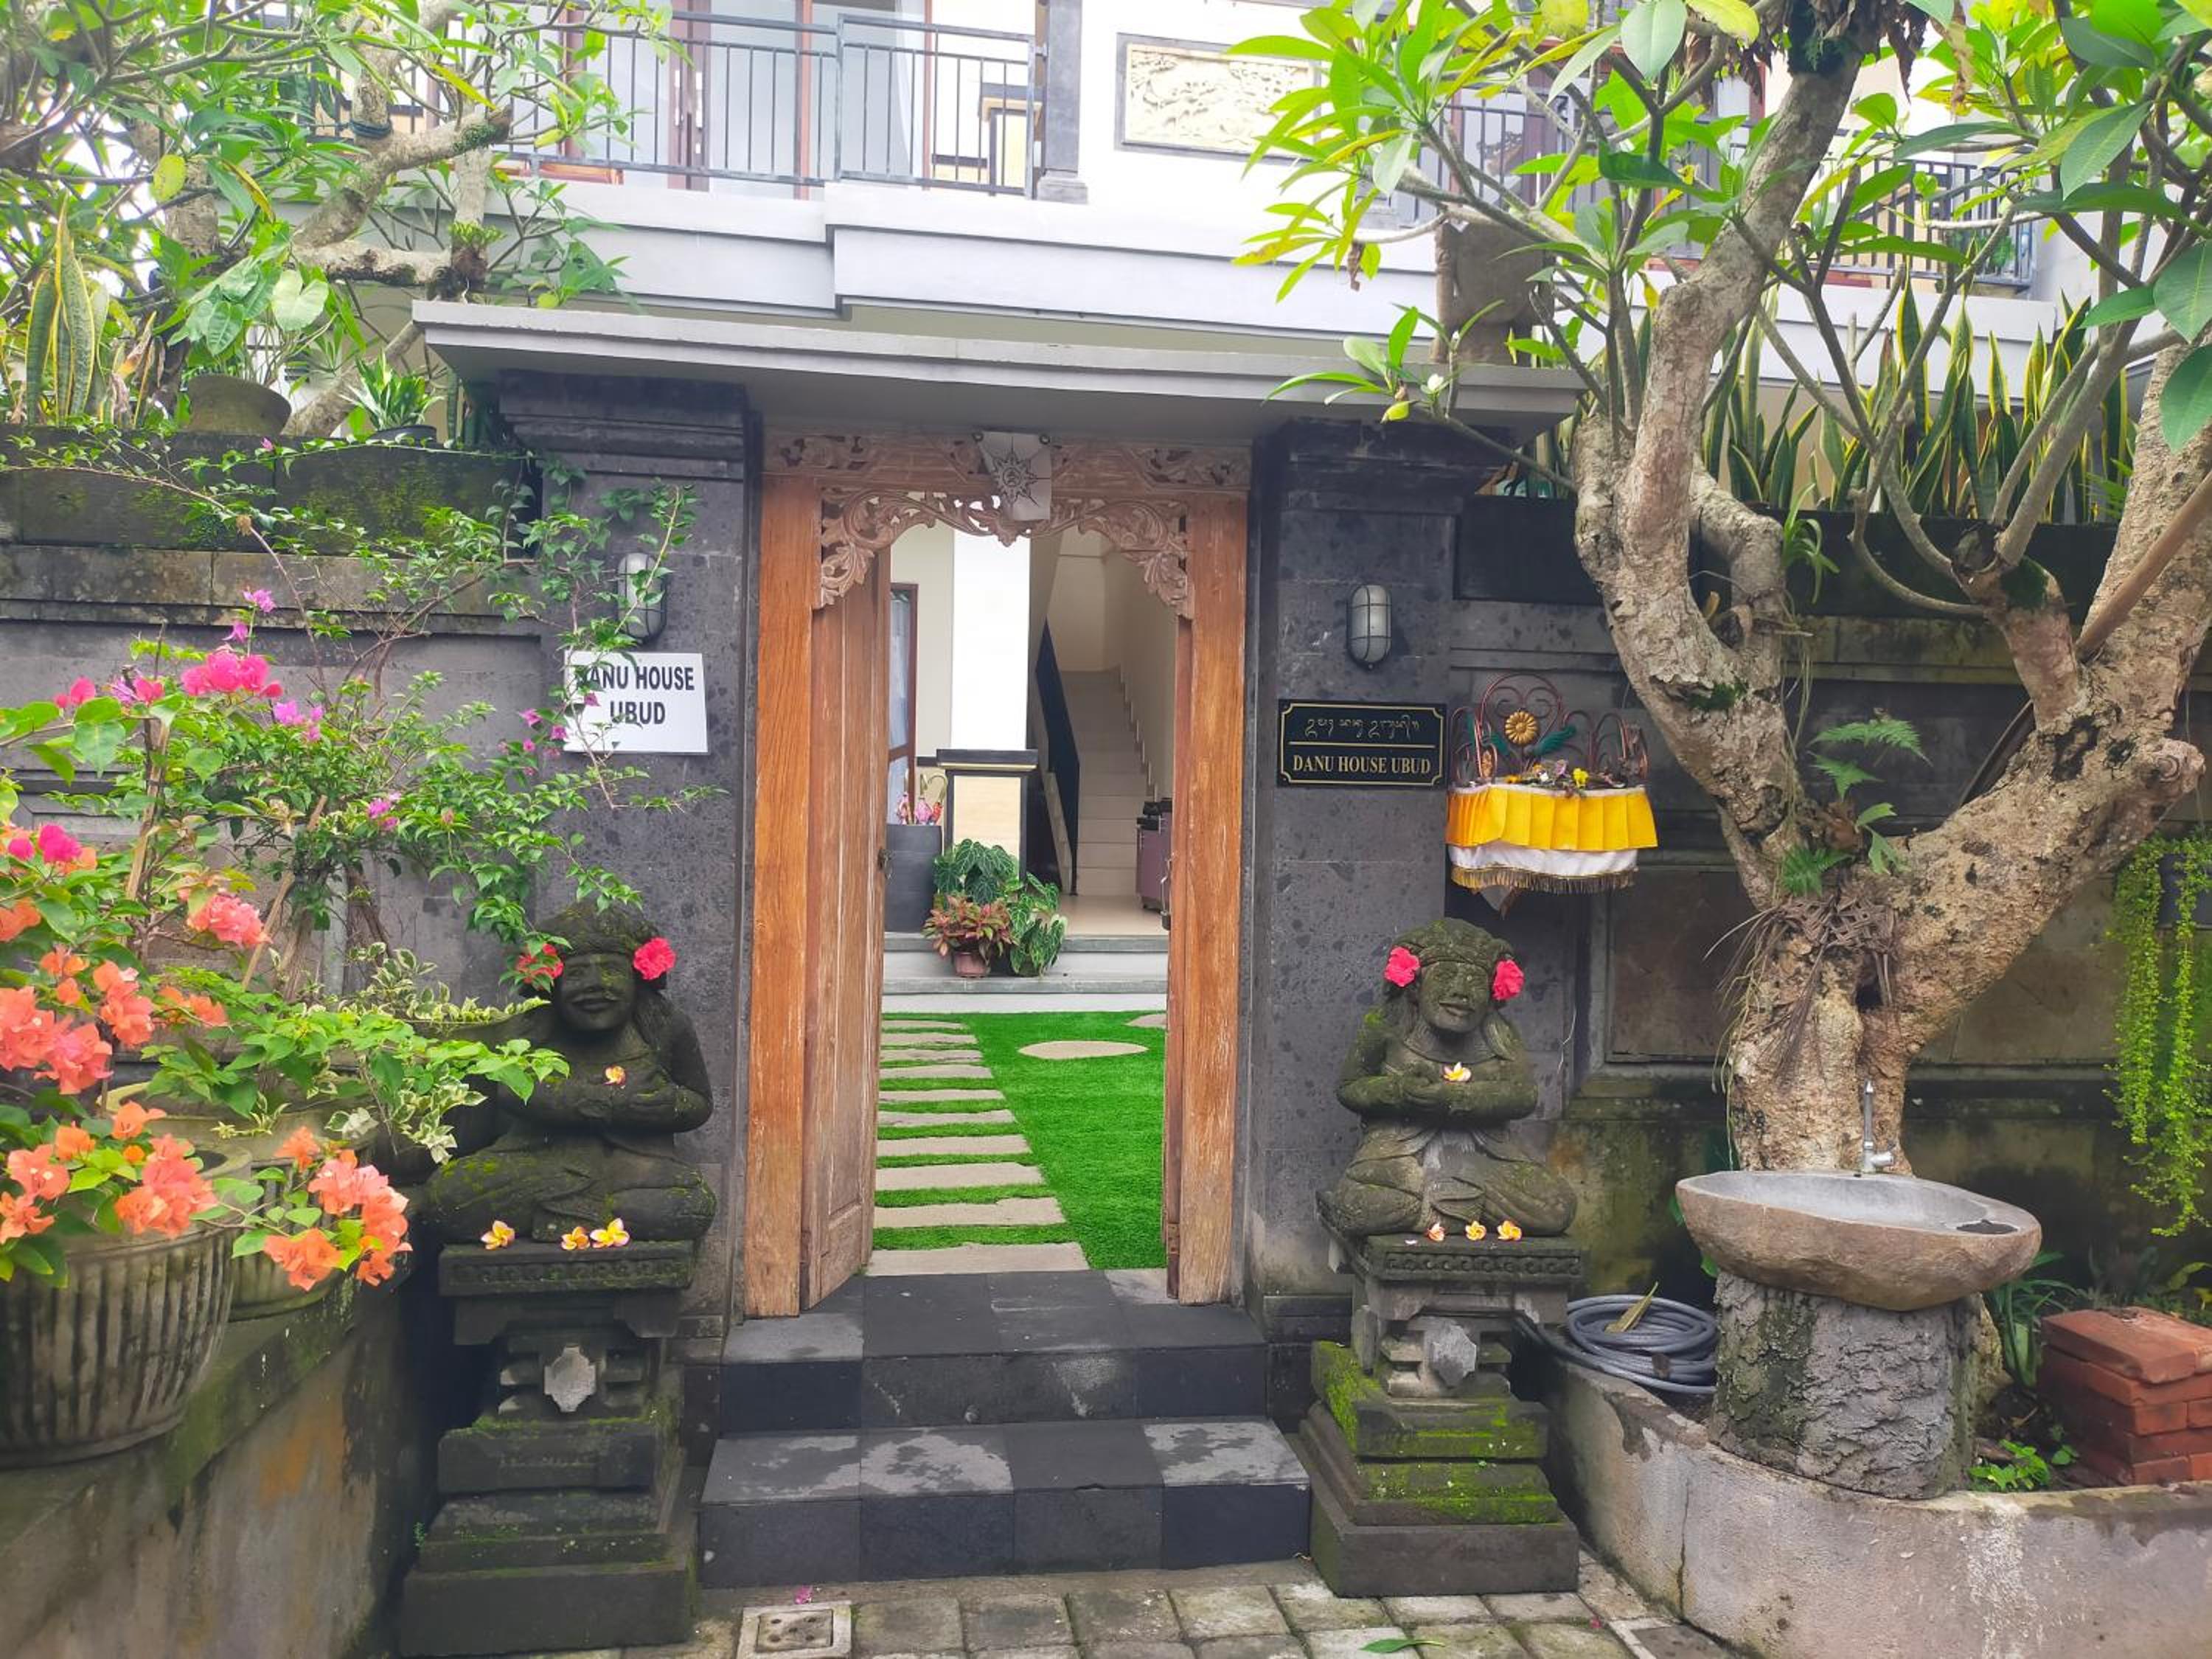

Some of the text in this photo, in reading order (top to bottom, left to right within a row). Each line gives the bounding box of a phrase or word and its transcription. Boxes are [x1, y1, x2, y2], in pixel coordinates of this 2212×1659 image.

[576, 666, 695, 691] ANU HOUSE
[610, 700, 666, 725] UBUD
[1293, 754, 1431, 774] DANU HOUSE UBUD
